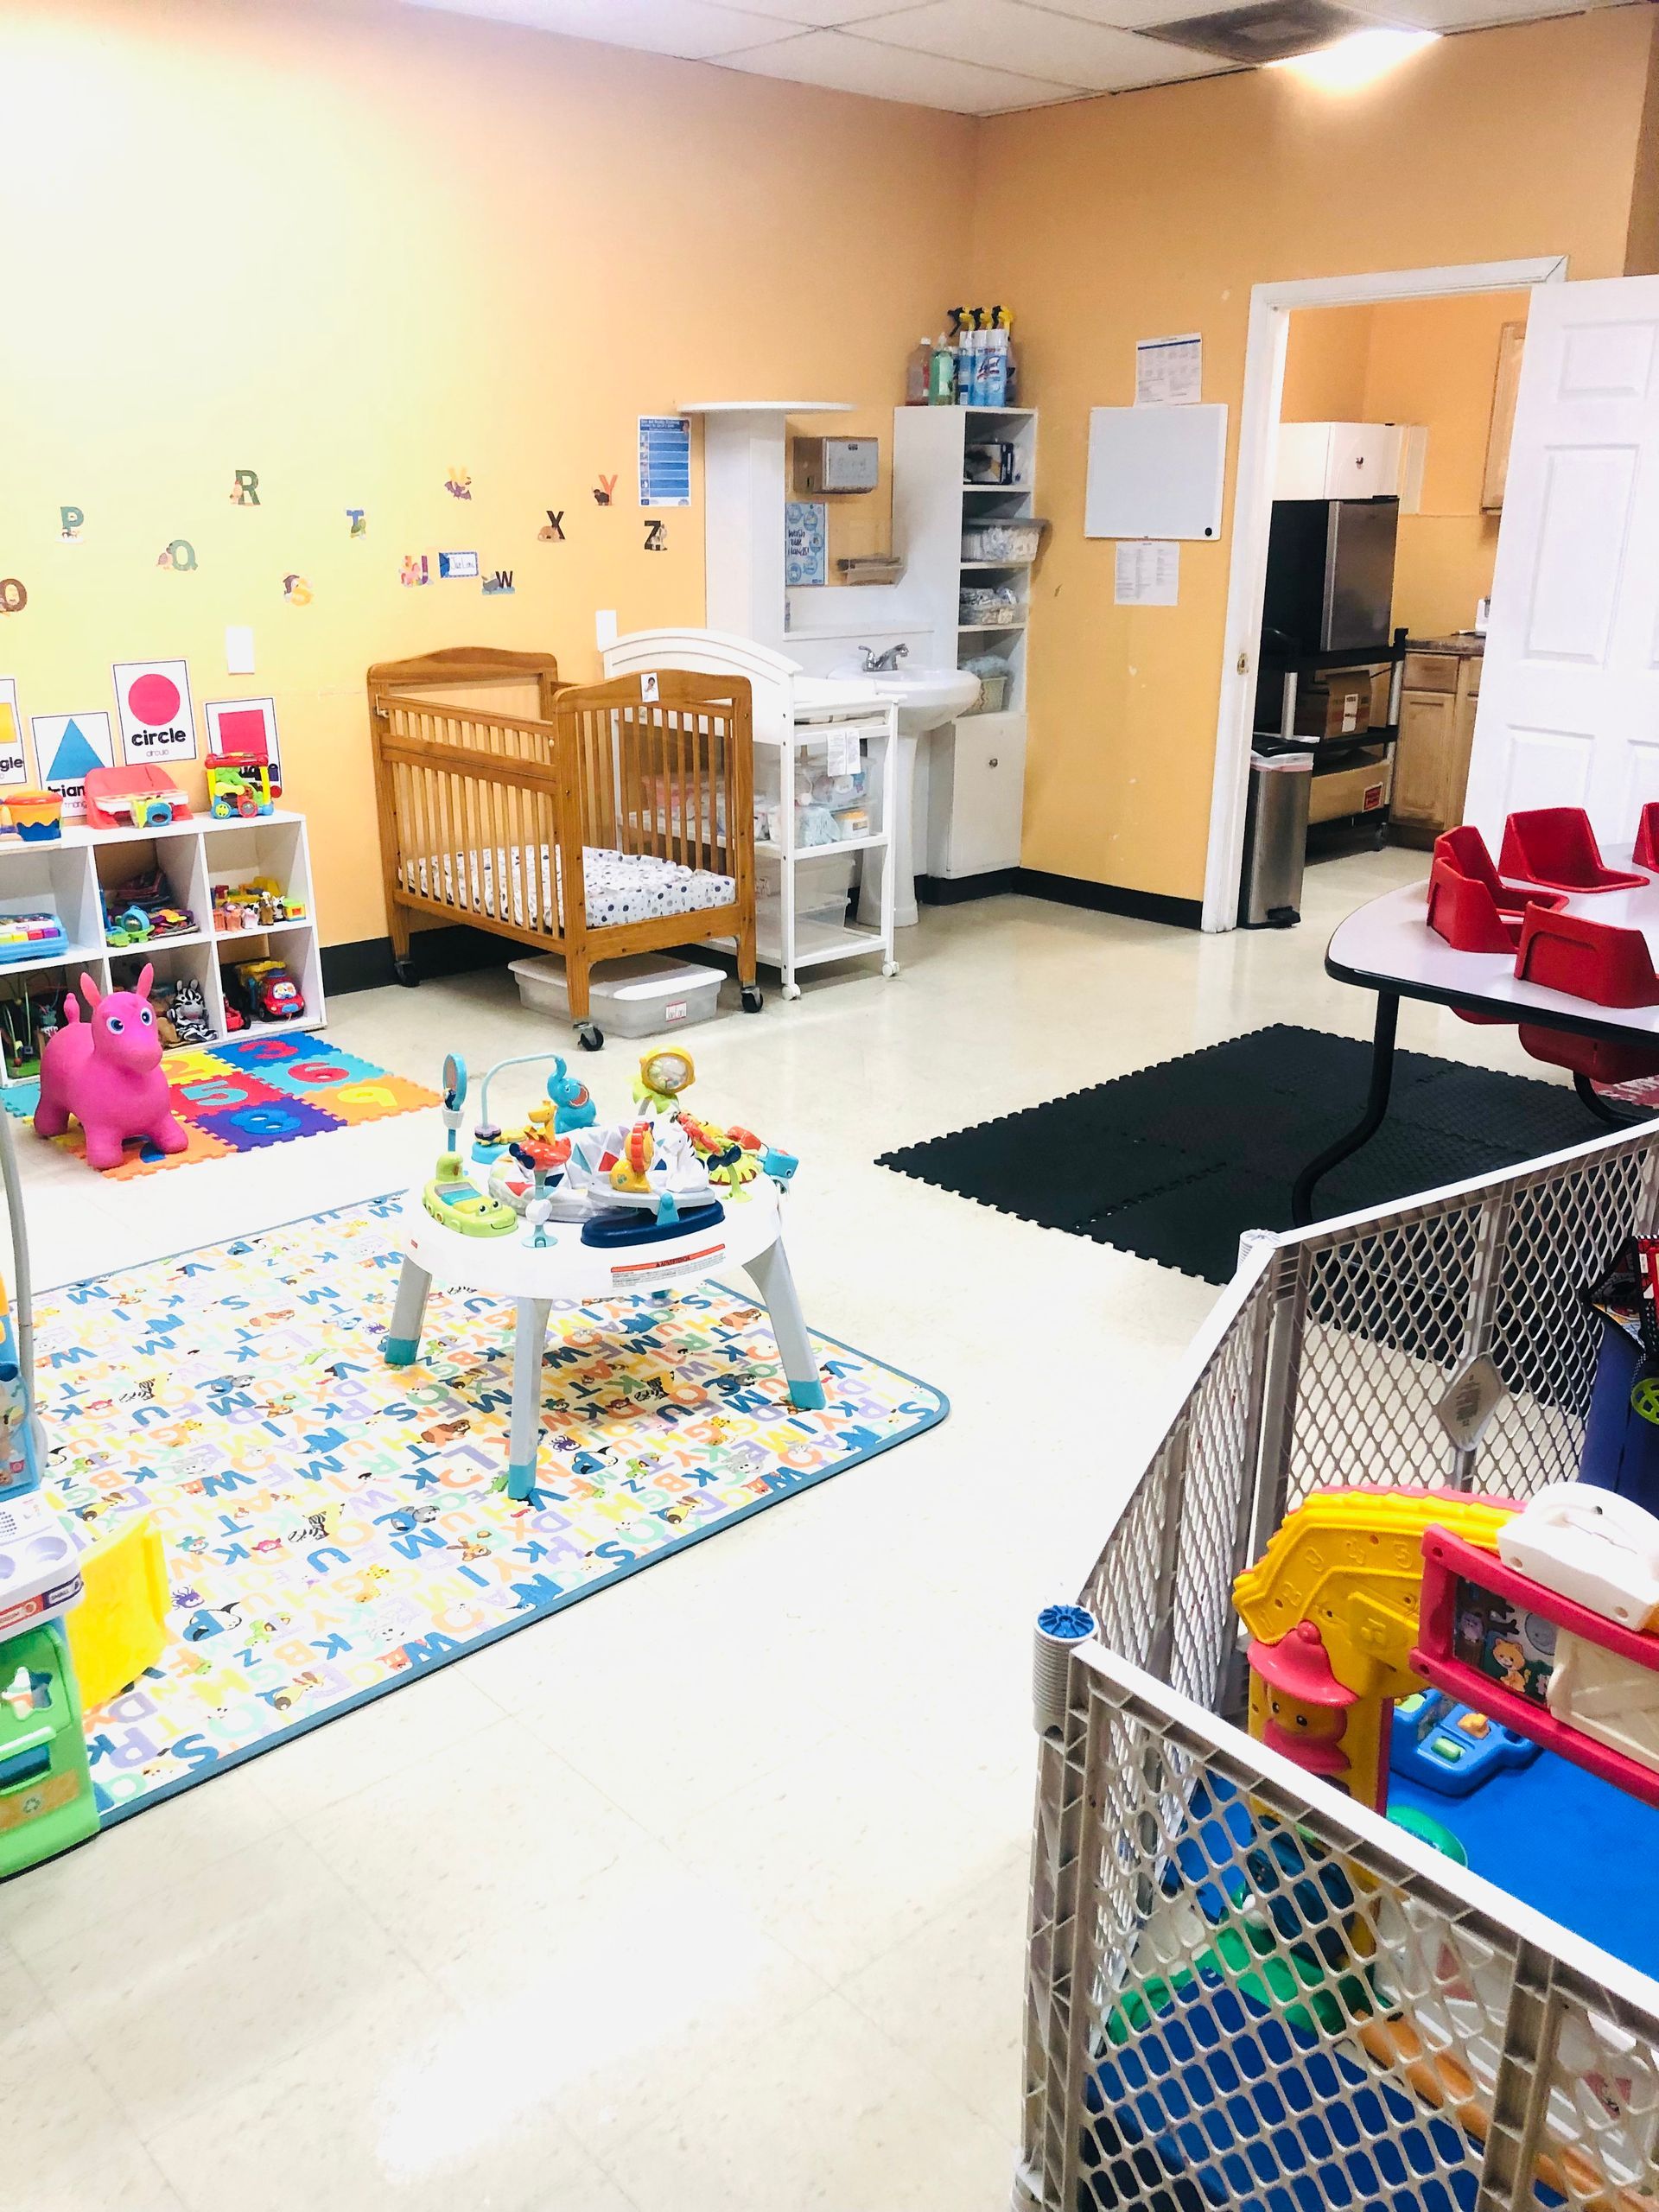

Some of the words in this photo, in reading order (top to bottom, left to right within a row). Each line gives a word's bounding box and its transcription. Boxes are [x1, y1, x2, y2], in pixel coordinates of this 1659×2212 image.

[235, 470, 261, 505] R
[599, 474, 618, 505] Y
[546, 511, 566, 540] X
[131, 728, 187, 747] circle
[238, 1039, 299, 1059] 3
[288, 1062, 350, 1083] 6
[180, 1080, 249, 1106] 5
[337, 1086, 398, 1107] 9
[230, 1109, 302, 1135] 8
